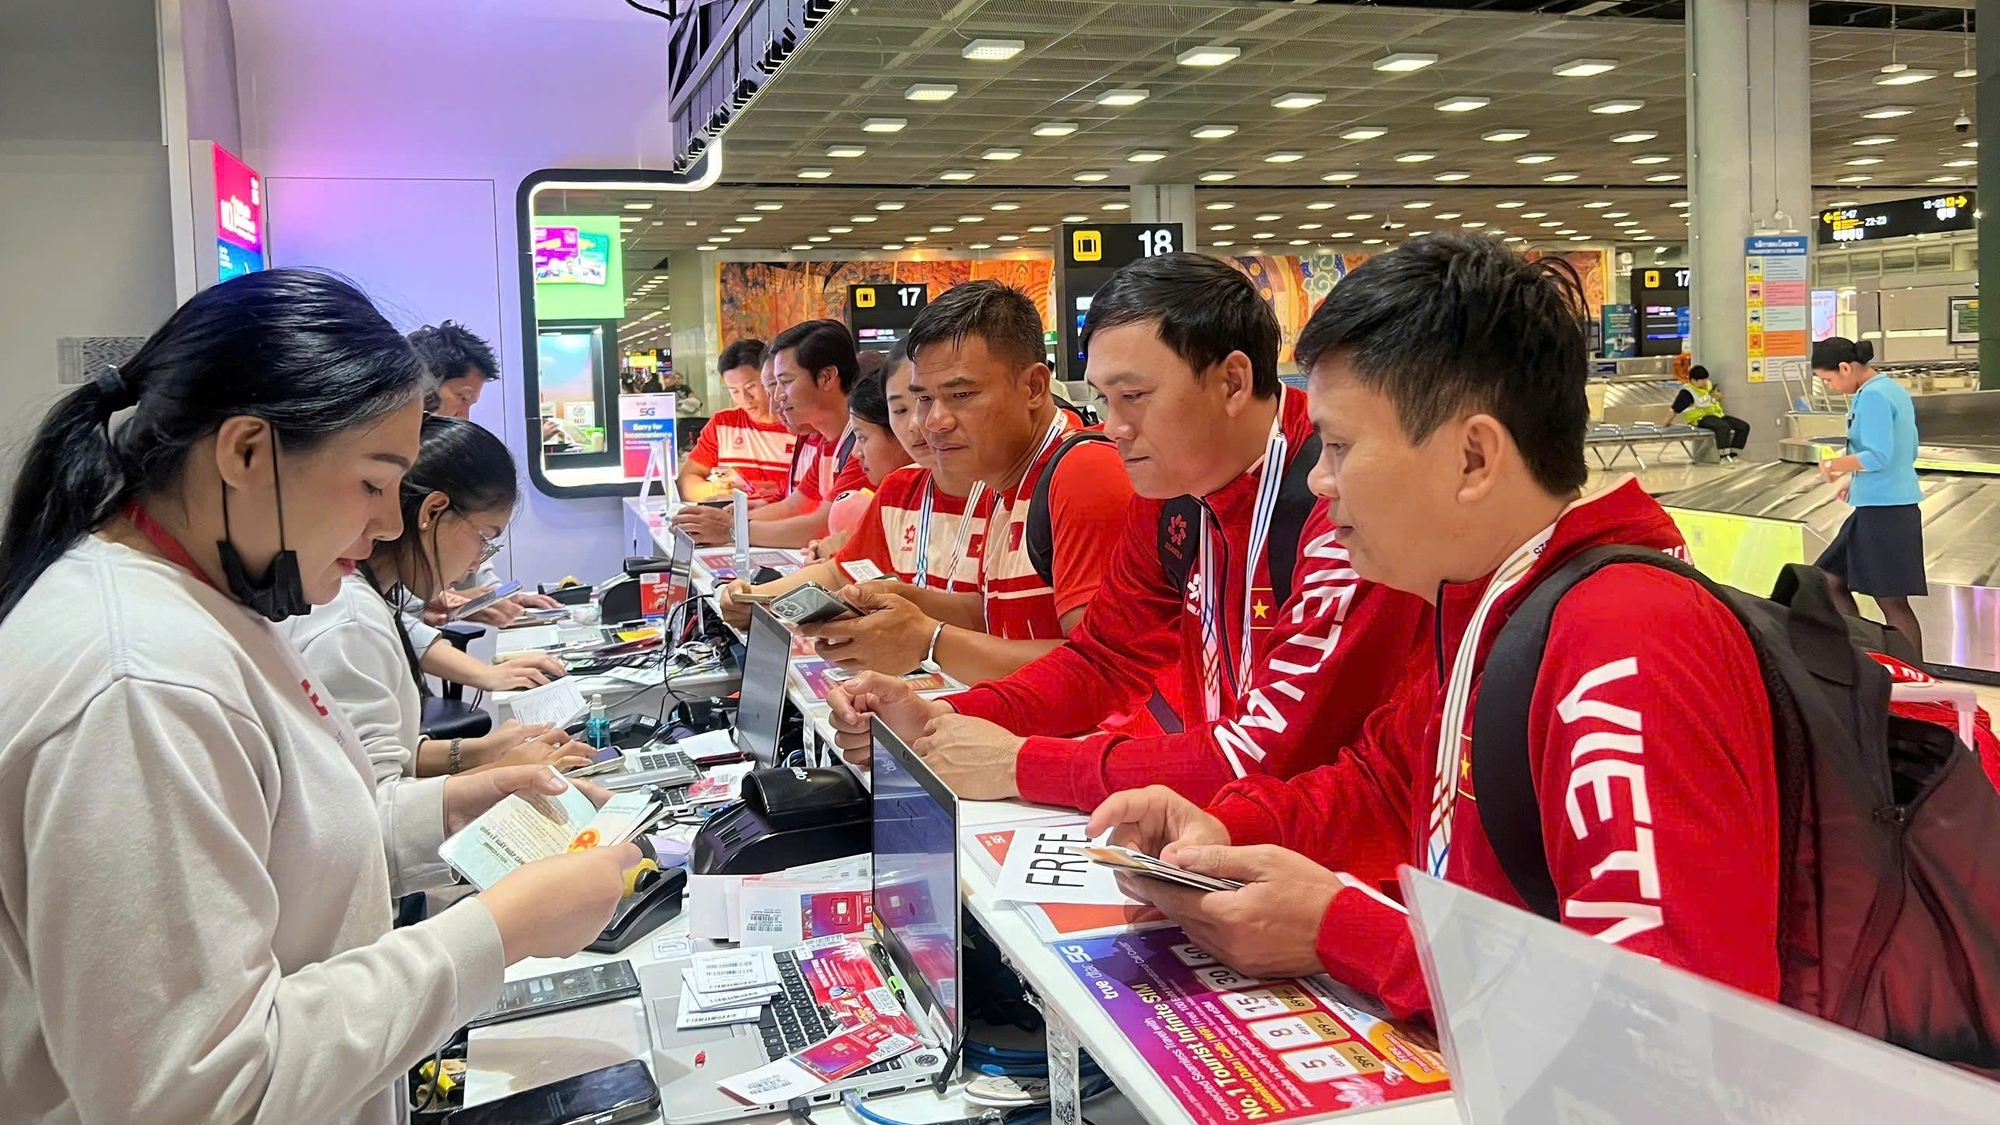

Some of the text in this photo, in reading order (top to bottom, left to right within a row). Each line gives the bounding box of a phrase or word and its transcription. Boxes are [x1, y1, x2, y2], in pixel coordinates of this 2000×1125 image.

[1138, 229, 1174, 258] 18
[1675, 270, 1690, 287] 17
[897, 287, 921, 307] 17
[663, 349, 671, 357] 11
[639, 407, 656, 417] 5G
[1059, 942, 1121, 1000] true dtac 5G
[1129, 981, 1164, 1004] SIM
[1285, 994, 1306, 1008] 699
[1172, 1000, 1190, 1011] 100
[1181, 945, 1328, 1070] 60 30 15 8 5
[1200, 999, 1221, 1015] eSIM
[1147, 1002, 1199, 1043] Infinite
[1182, 1010, 1201, 1024] Free
[1213, 1012, 1232, 1025] and
[1194, 1024, 1217, 1040] WiFi
[1223, 1023, 1243, 1036] SIM
[1315, 1022, 1339, 1037] 499
[1209, 1041, 1235, 1059] Calls
[1234, 1033, 1269, 1059] physical
[1291, 1022, 1312, 1036] days
[1324, 1052, 1347, 1068] days
[1384, 1044, 1413, 1064] Free
[1143, 1017, 1241, 1121] Connected Seamless Travel with
[1183, 1041, 1239, 1088] Tourist
[1228, 1059, 1254, 1078] Data
[1256, 1057, 1280, 1073] both
[1351, 1053, 1376, 1069] 399
[1244, 1076, 1287, 1113] Unlimited
[1277, 1077, 1316, 1109] Available
